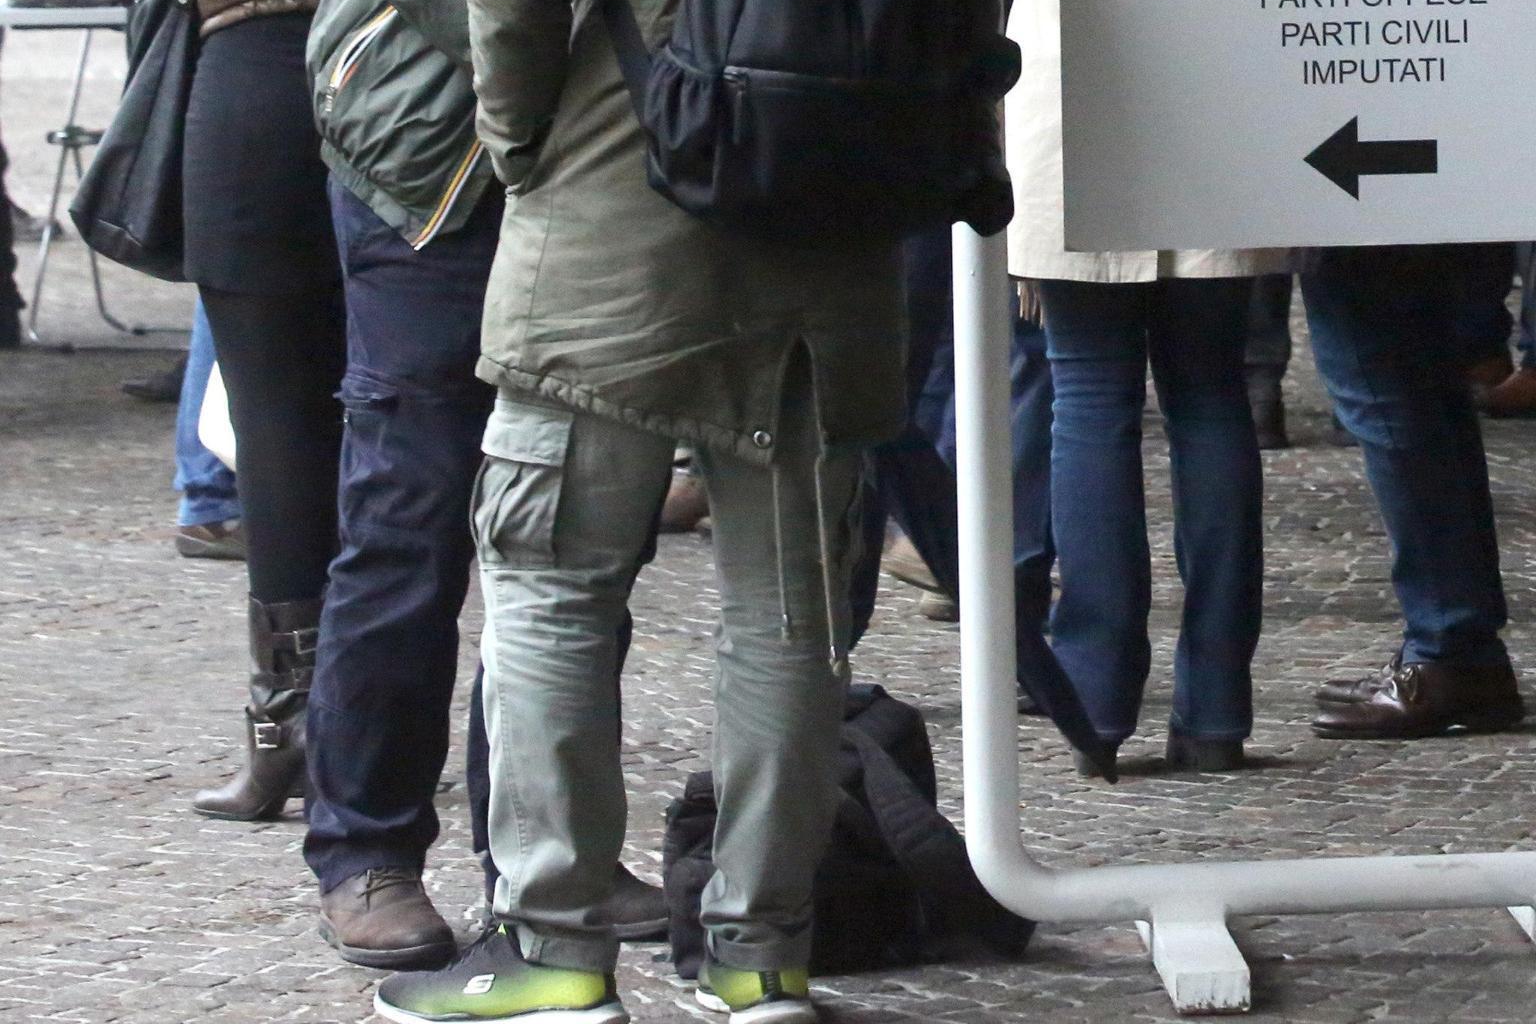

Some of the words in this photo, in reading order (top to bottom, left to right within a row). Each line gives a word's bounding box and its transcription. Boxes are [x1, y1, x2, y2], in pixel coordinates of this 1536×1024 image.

[1281, 21, 1370, 48] PARTI
[1381, 19, 1469, 45] CIVILI
[1303, 57, 1445, 85] IMPUTATI
